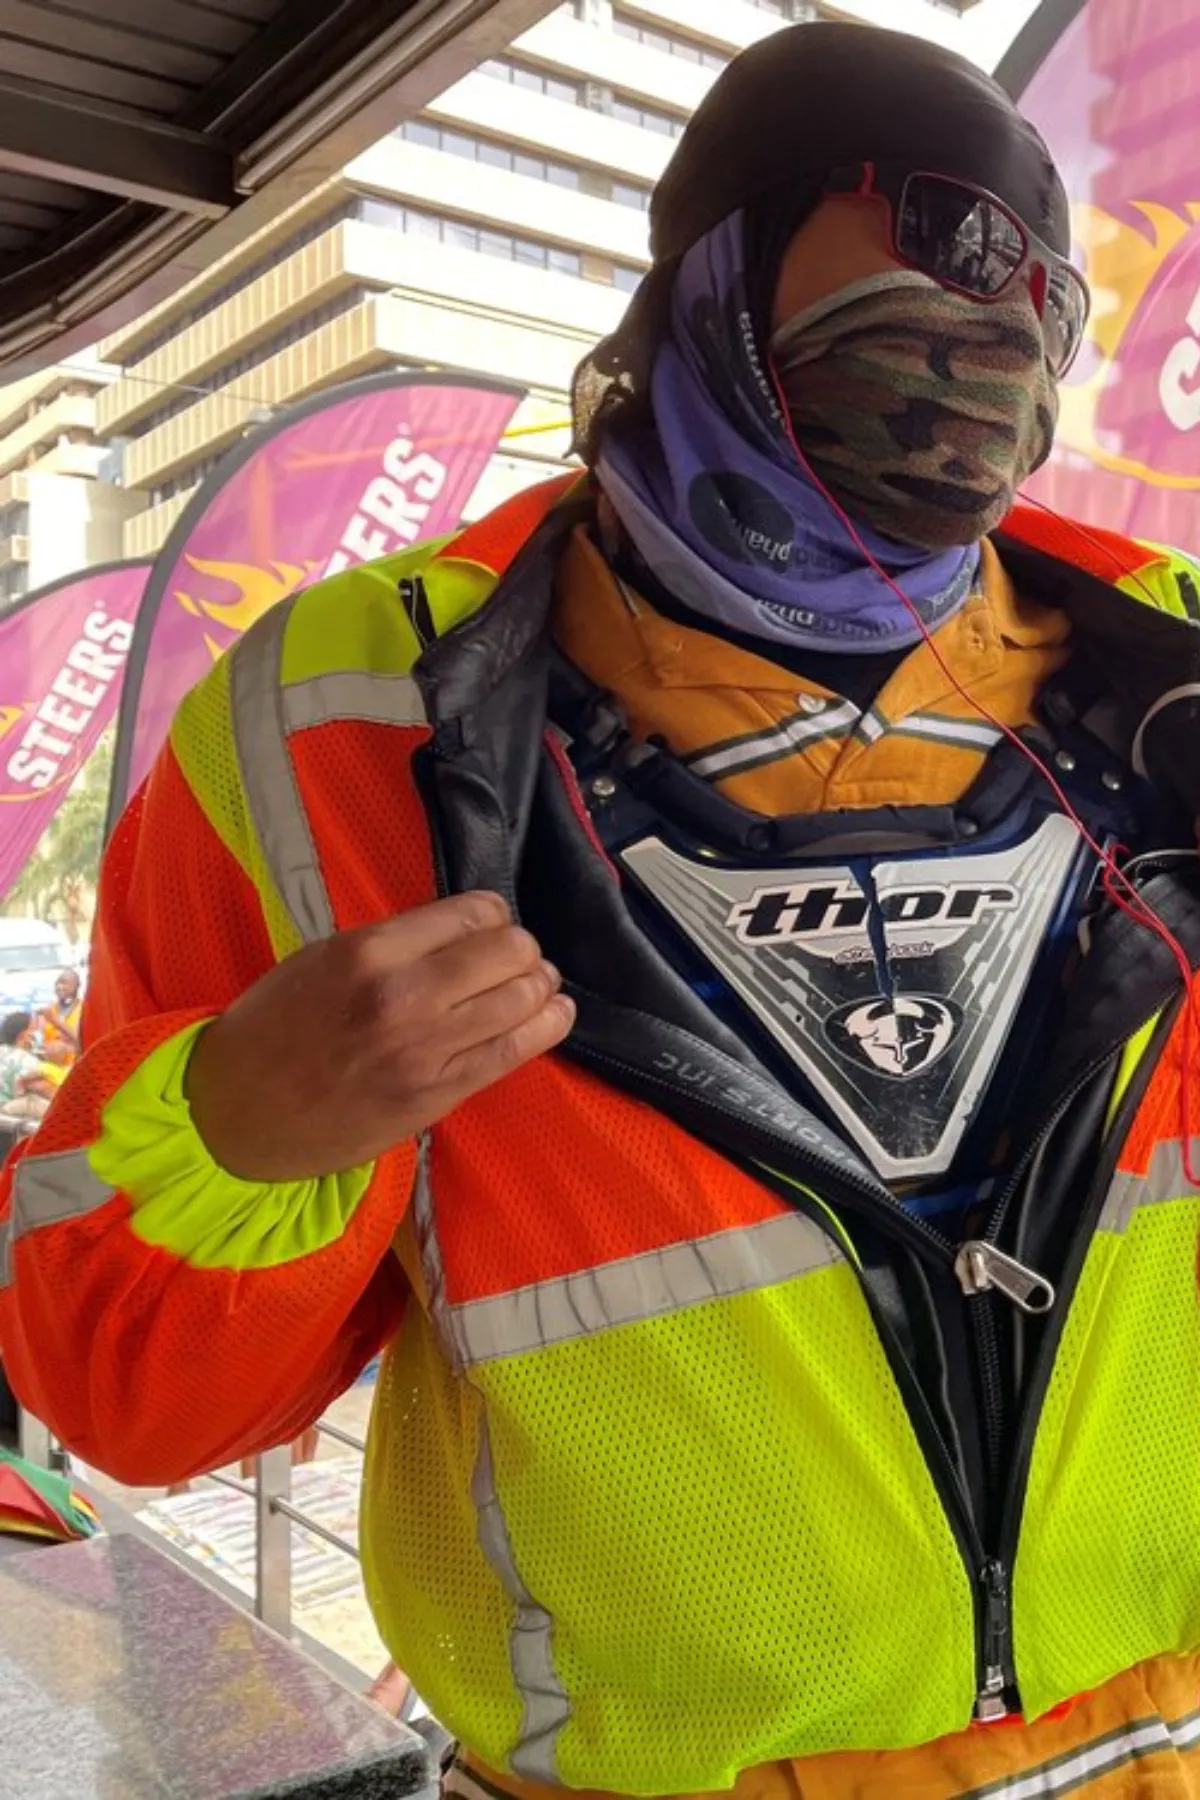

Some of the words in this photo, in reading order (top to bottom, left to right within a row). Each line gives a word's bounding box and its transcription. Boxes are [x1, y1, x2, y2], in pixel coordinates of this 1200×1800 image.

[322, 438, 447, 579] ERS
[7, 611, 135, 788] STEERS
[737, 886, 1015, 937] thor
